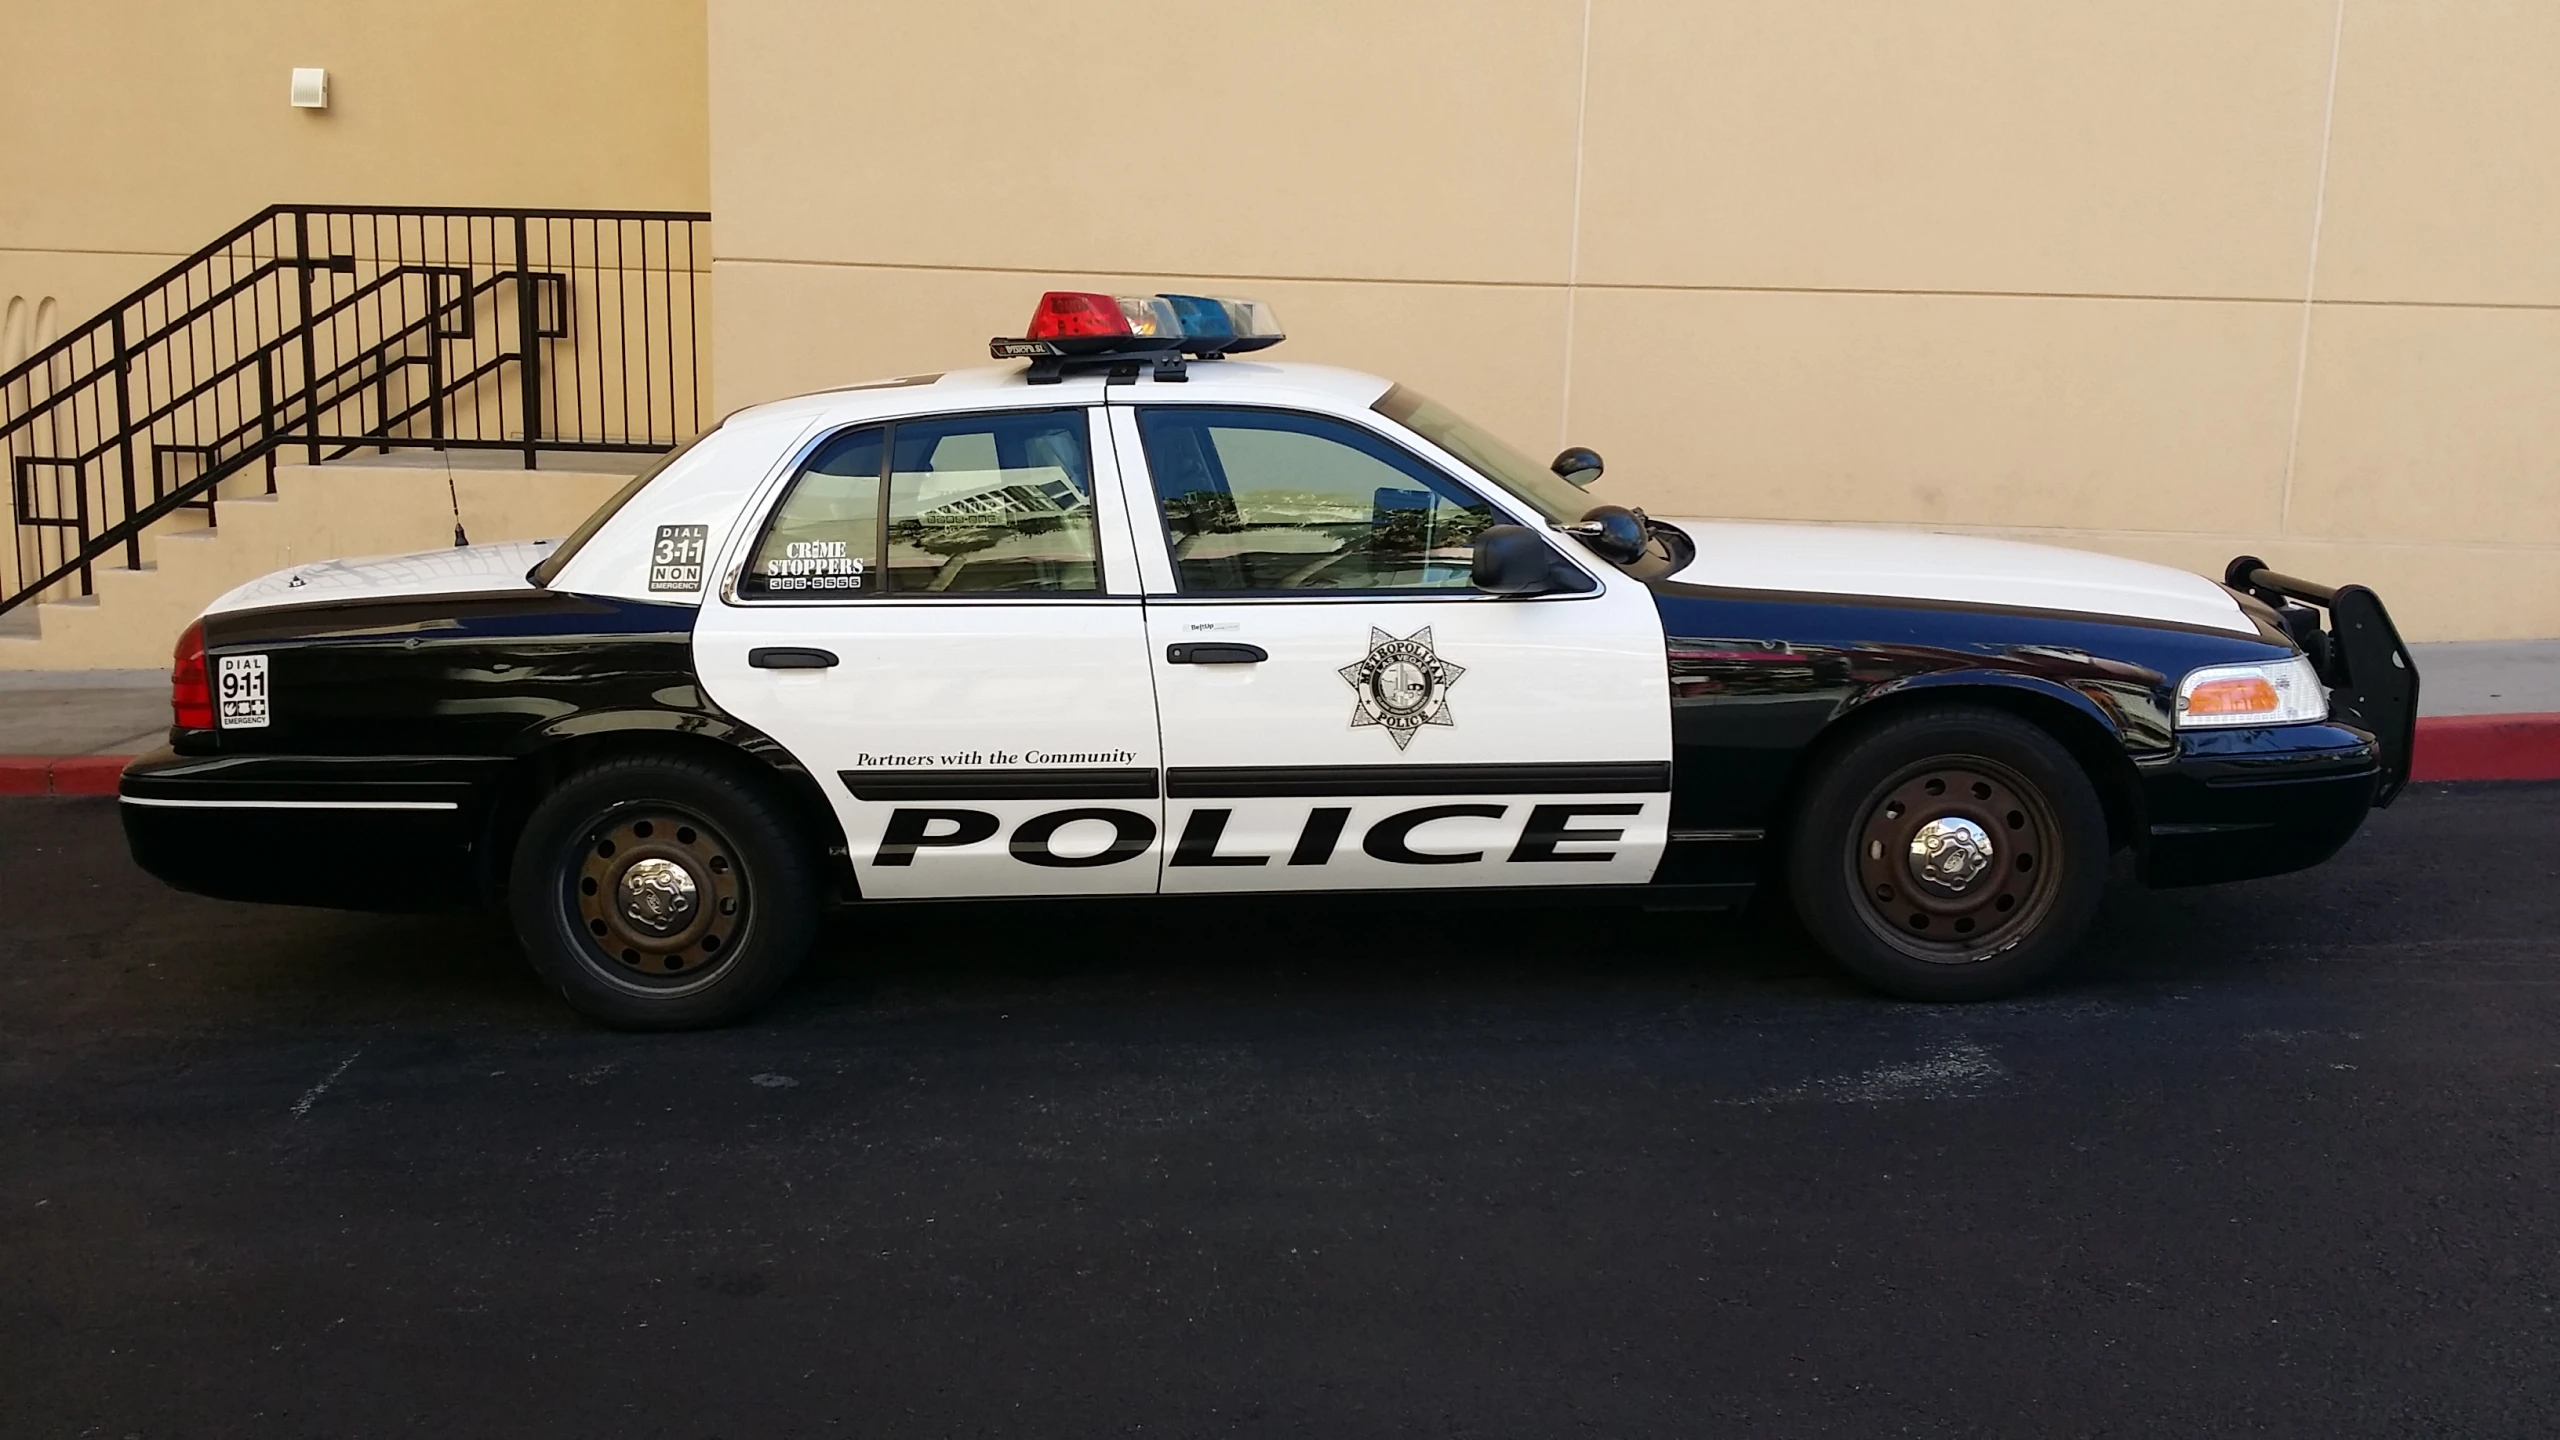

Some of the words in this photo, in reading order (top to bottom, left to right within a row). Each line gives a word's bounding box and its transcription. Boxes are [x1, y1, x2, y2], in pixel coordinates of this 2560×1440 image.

[662, 528, 702, 538] DIAL
[655, 568, 698, 580] NON
[767, 558, 864, 577] STOPPERS
[651, 582, 700, 590] EMERGENCY
[226, 659, 261, 670] DIAL
[1360, 642, 1444, 685] METROPOLITAN
[1377, 657, 1395, 674] LAS
[1396, 654, 1428, 674] VEGAS
[224, 717, 266, 726] EMERGENCY
[1377, 711, 1429, 728] POLICE
[856, 752, 935, 767] Partners
[940, 750, 983, 766] with
[988, 750, 1019, 765] the
[1024, 748, 1138, 766] Community
[871, 803, 1645, 868] POLICE
